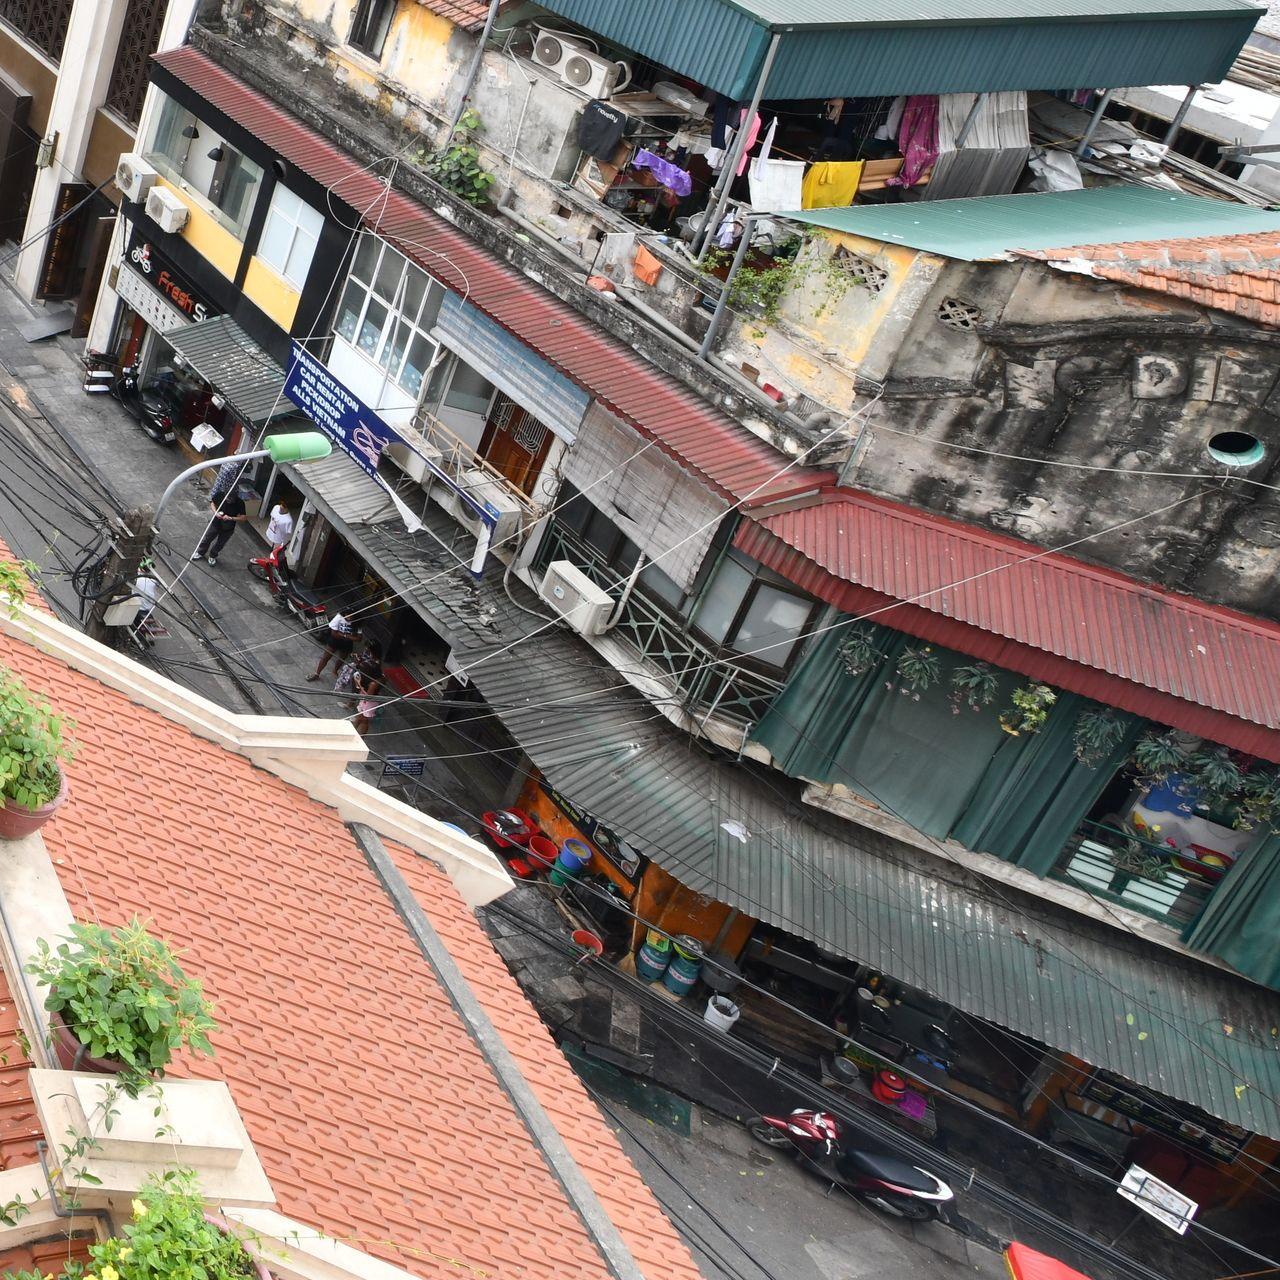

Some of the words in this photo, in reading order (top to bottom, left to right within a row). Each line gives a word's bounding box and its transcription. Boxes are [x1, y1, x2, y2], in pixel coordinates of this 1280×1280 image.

[158, 270, 194, 313] Fresh
[292, 346, 360, 414] TRANSPORTATION
[300, 366, 316, 387] CAR
[316, 383, 346, 414] RENTAL
[301, 379, 342, 420] PICK/DROP
[311, 401, 346, 439] VIETNAM
